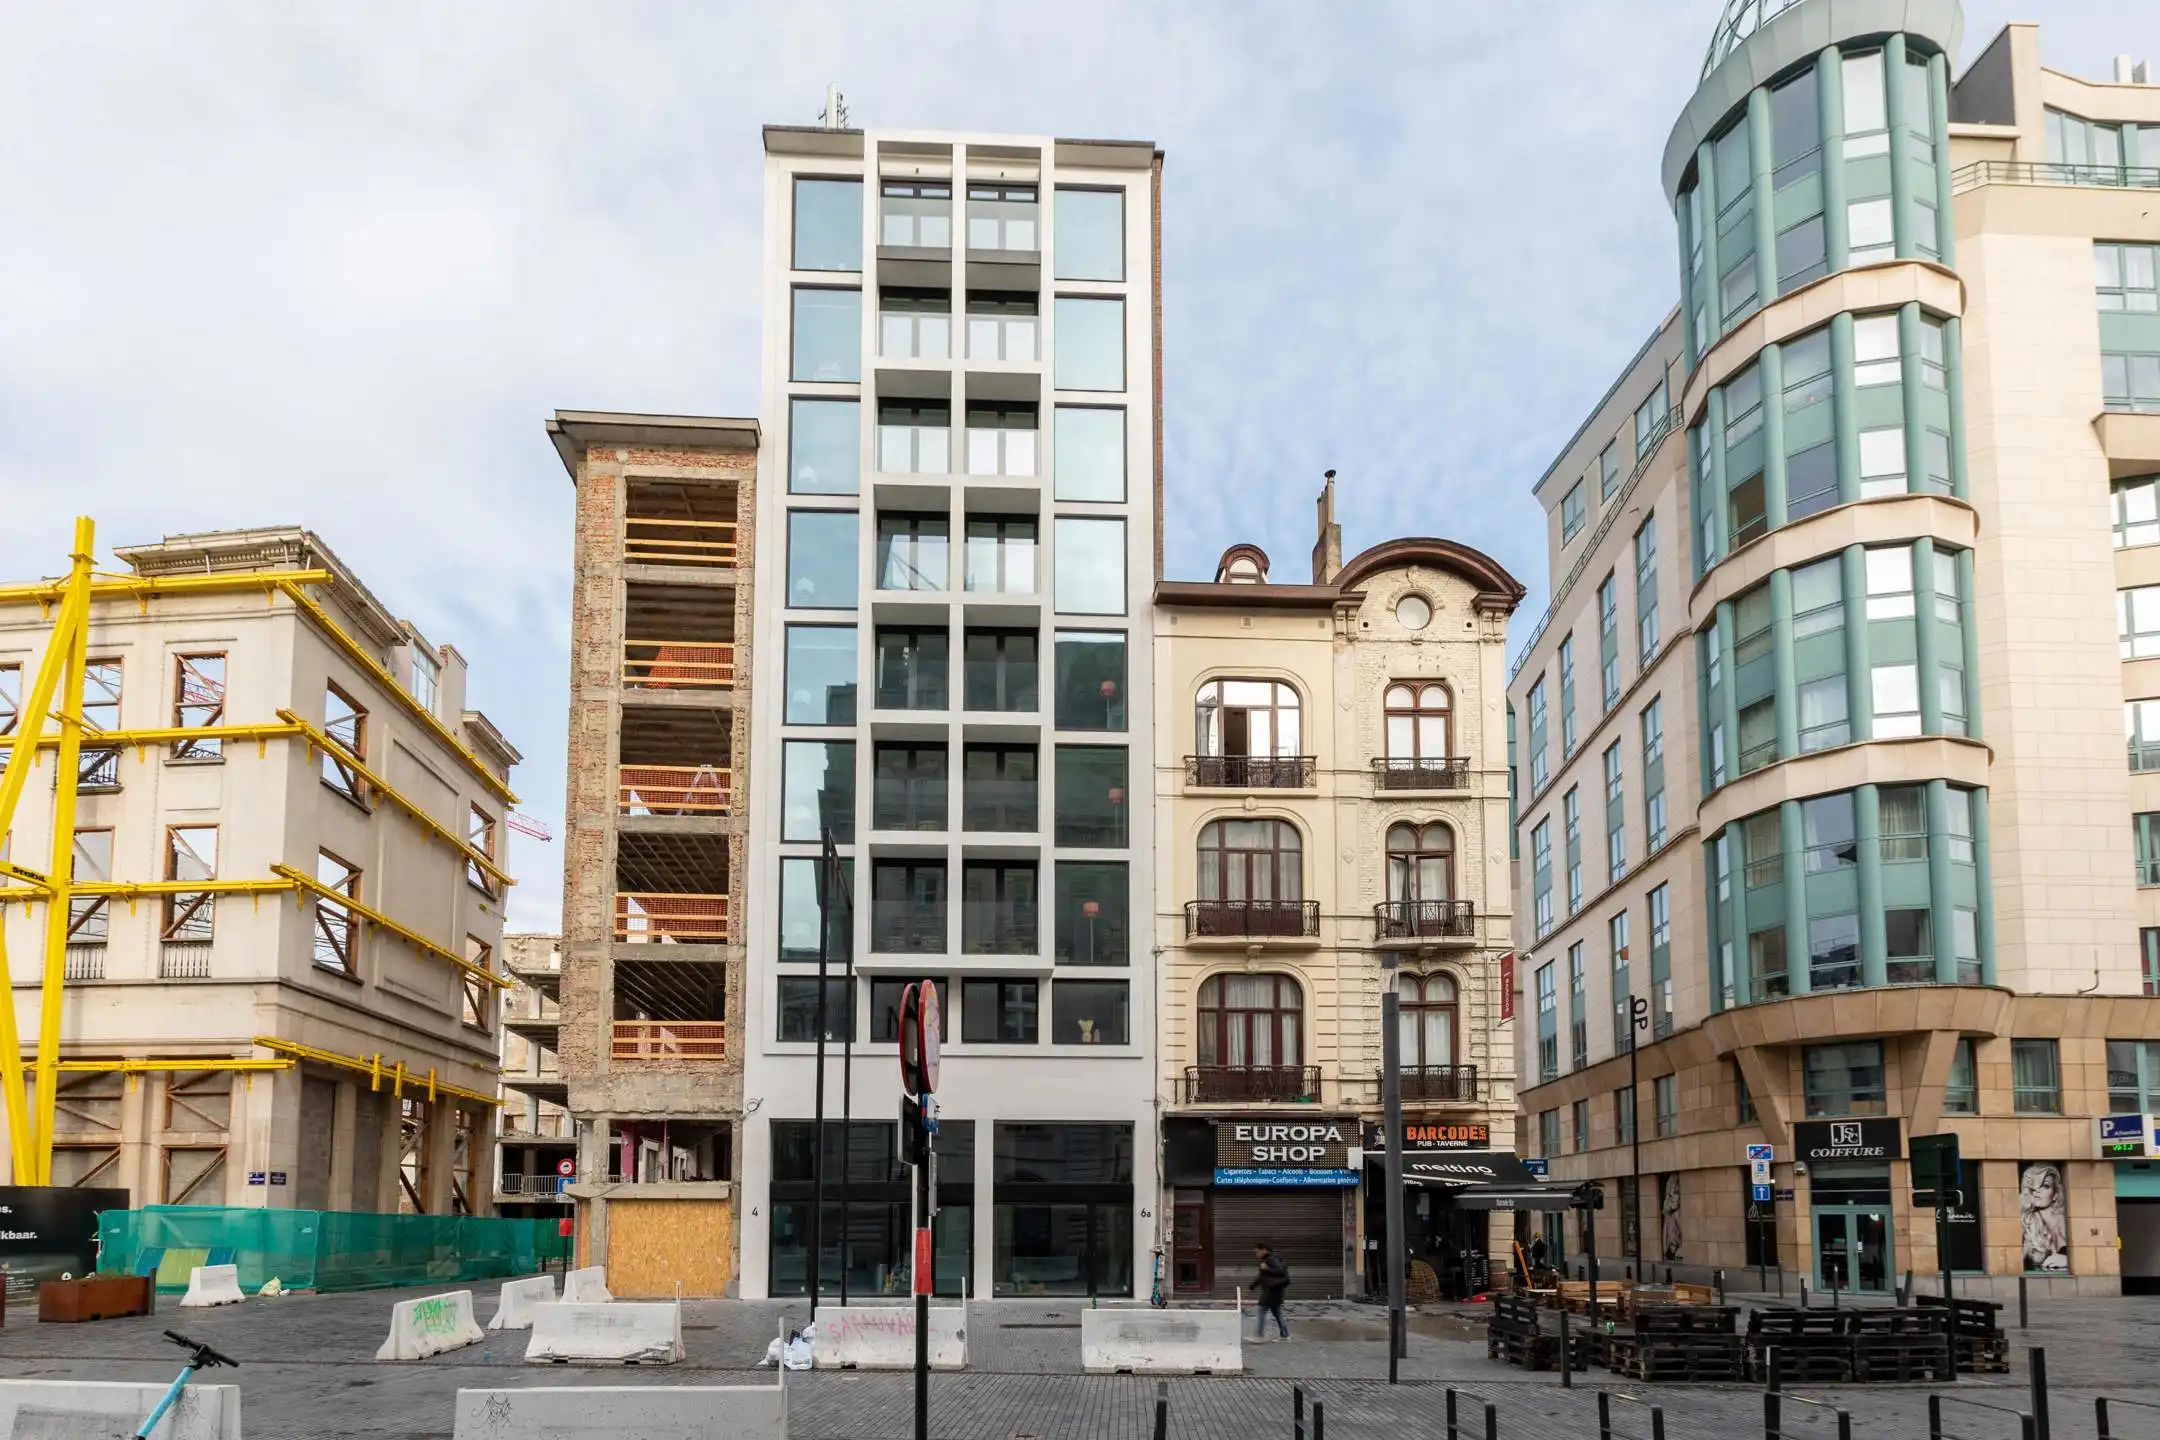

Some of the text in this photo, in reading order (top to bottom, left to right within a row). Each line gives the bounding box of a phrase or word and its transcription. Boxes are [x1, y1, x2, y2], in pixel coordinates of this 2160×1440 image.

[1235, 1125, 1342, 1141] EUROPA
[1406, 1126, 1478, 1141] BARCODE
[2102, 1120, 2114, 1137] P
[1252, 1146, 1326, 1161] SHOP
[1810, 1147, 1884, 1158] COIFFURE
[752, 1206, 759, 1217] 4
[1141, 1208, 1152, 1218] 6a
